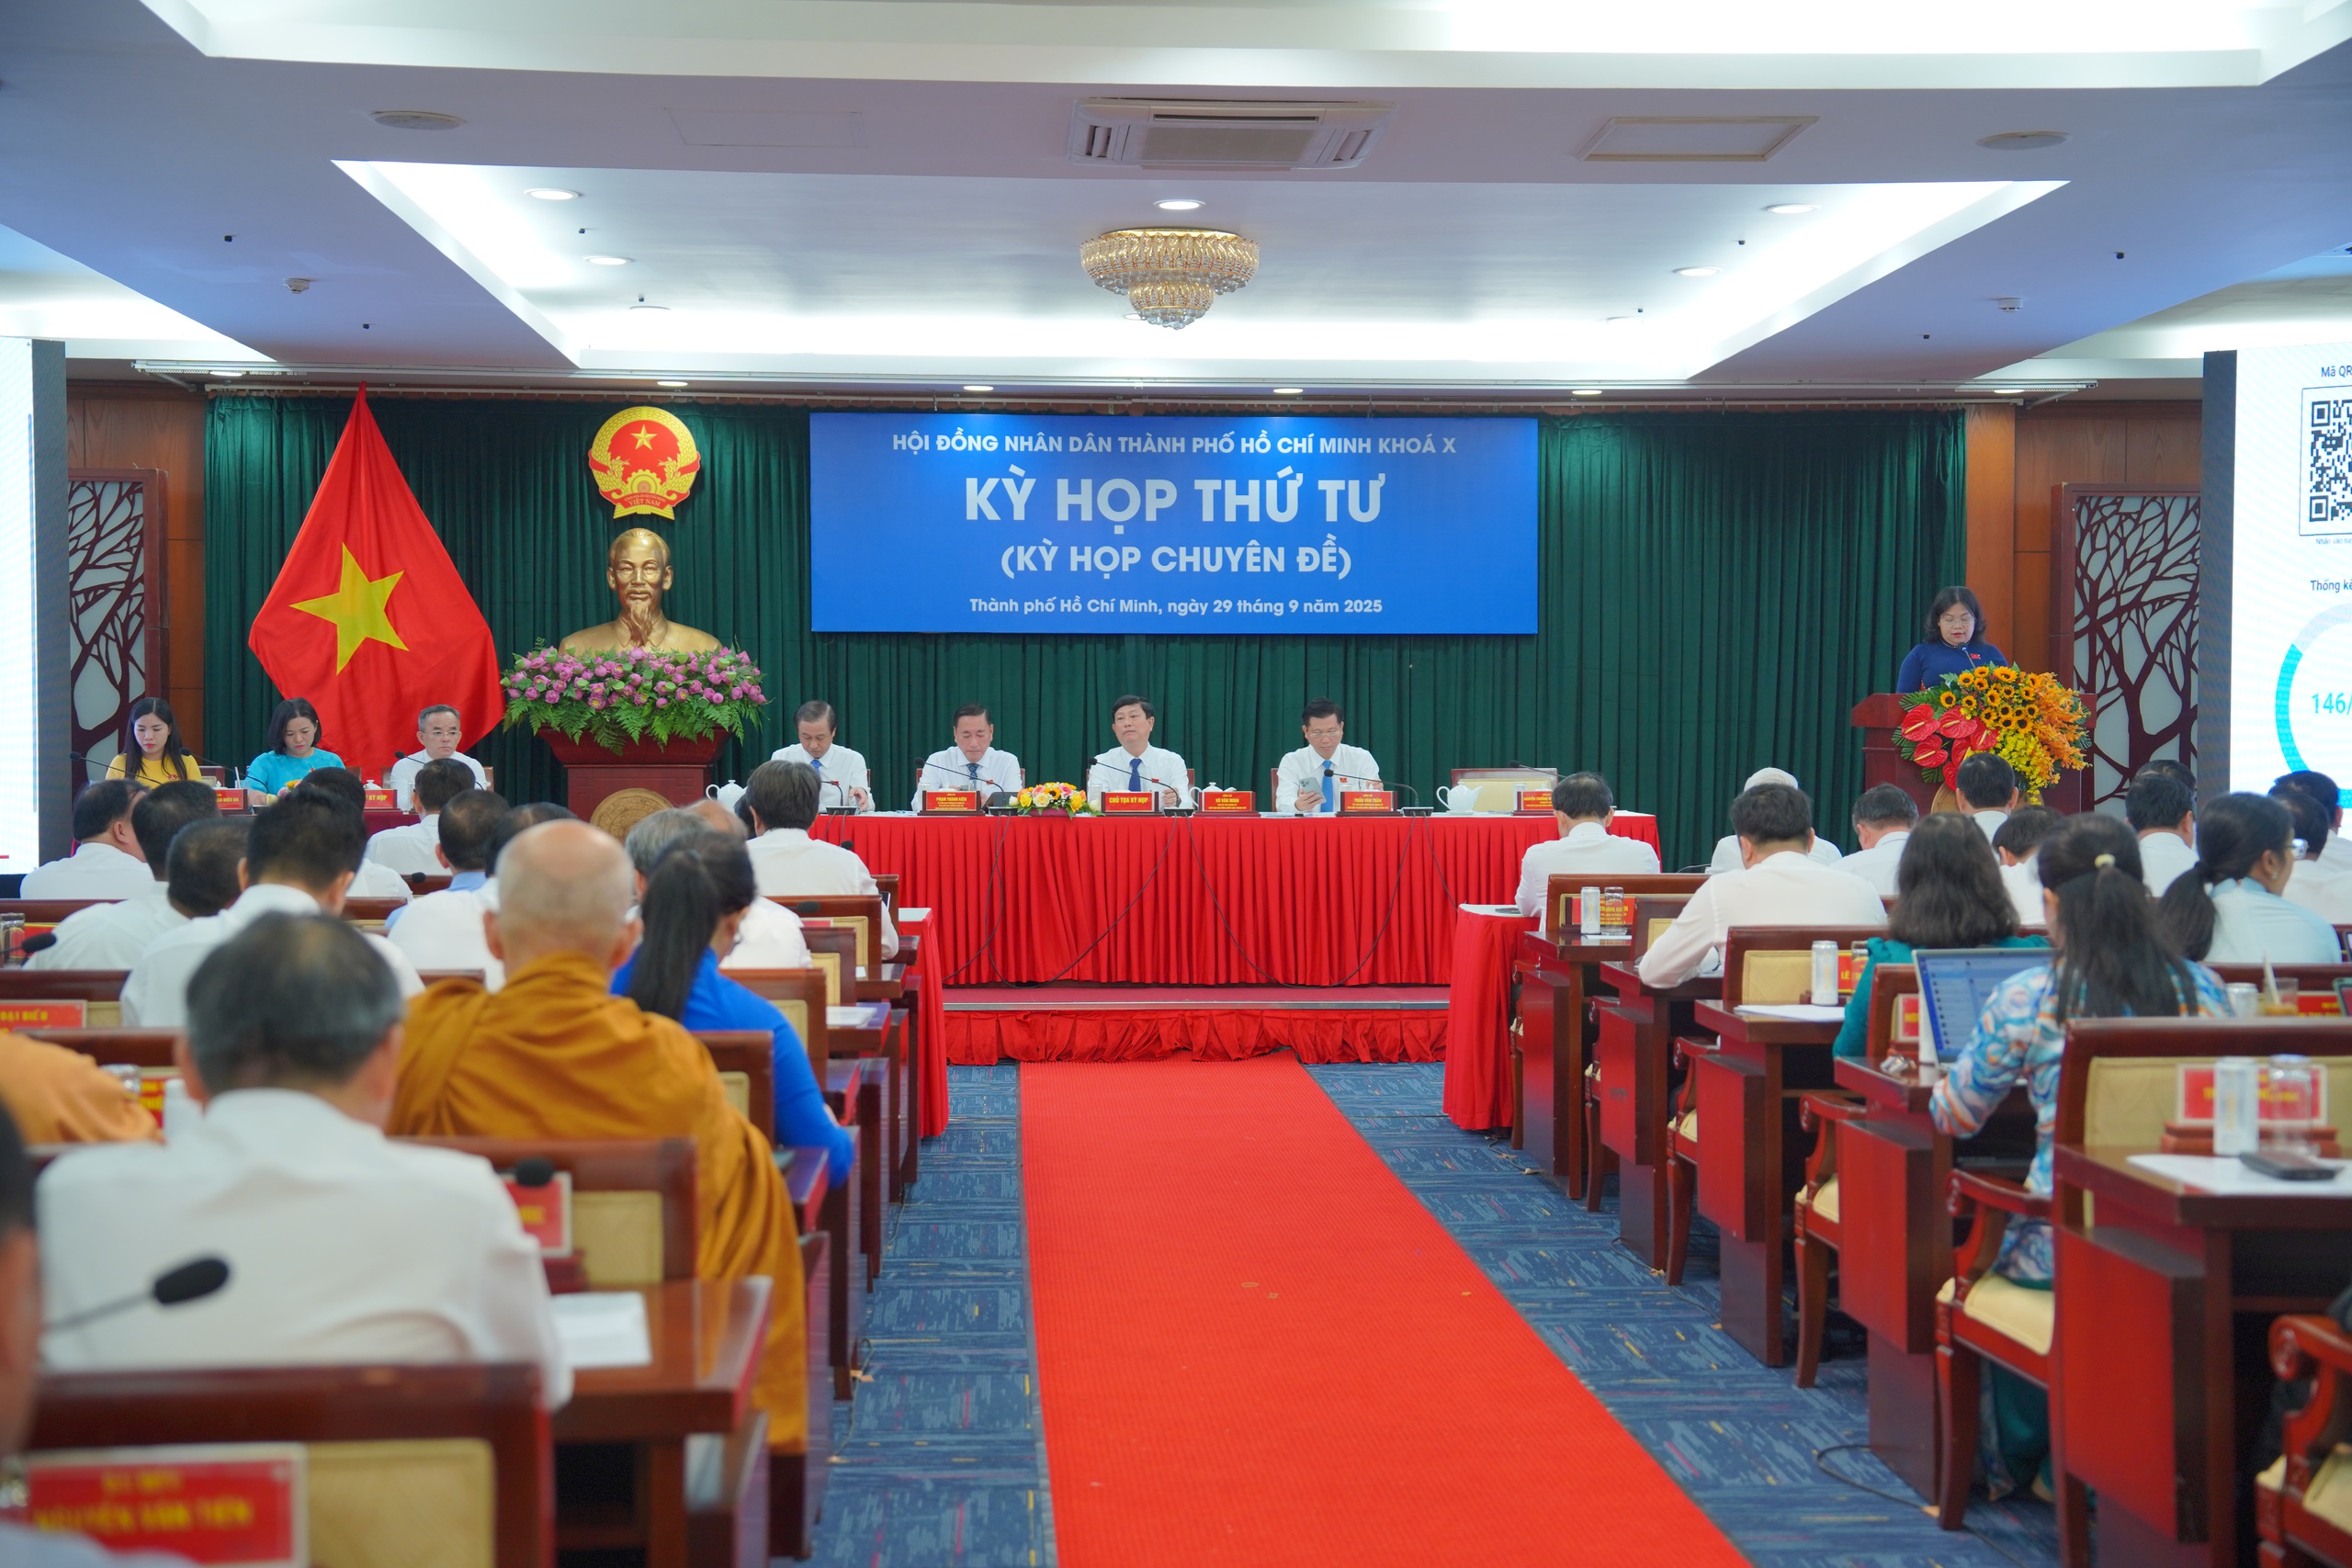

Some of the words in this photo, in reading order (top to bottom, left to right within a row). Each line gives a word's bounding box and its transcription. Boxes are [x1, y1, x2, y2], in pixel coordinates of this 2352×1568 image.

[2321, 366, 2336, 378] Mã
[892, 430, 930, 455] HỘI
[935, 427, 999, 452] ĐỒNG
[1005, 431, 1062, 452] NHÂN
[1069, 432, 1112, 453] DÂN
[1118, 433, 1185, 453] THÀNH
[1192, 431, 1235, 453] PHỐ
[1241, 429, 1272, 453] HỒ
[1277, 433, 1315, 453] CHÍ
[1319, 438, 1372, 453] MINH
[1379, 433, 1437, 453] KHOÁ
[1442, 437, 1457, 453] X
[628, 497, 644, 505] VIỆT
[645, 498, 661, 507] NAM
[966, 465, 1036, 521] KỲ
[1057, 479, 1177, 535] HỌP
[1193, 466, 1304, 523] THỨ
[1317, 473, 1385, 523] TƯ
[1001, 538, 1059, 579] (KỲ
[1069, 547, 1141, 580] HỌP
[1151, 540, 1285, 572] CHUYÊN
[1296, 534, 1351, 579] ĐỀ)
[2310, 578, 2340, 593] Thống
[969, 598, 1018, 612] Thành
[1023, 597, 1057, 615] phố
[1060, 596, 1082, 613] Hồ
[1087, 599, 1115, 613] Chí
[1119, 599, 1163, 615] Minh,
[1168, 599, 1208, 616] ngày
[1213, 599, 1233, 613] 29
[1237, 599, 1284, 616] tháng
[1288, 599, 1299, 613] 9
[1304, 599, 1340, 613] năm
[1344, 599, 1384, 613] 2025
